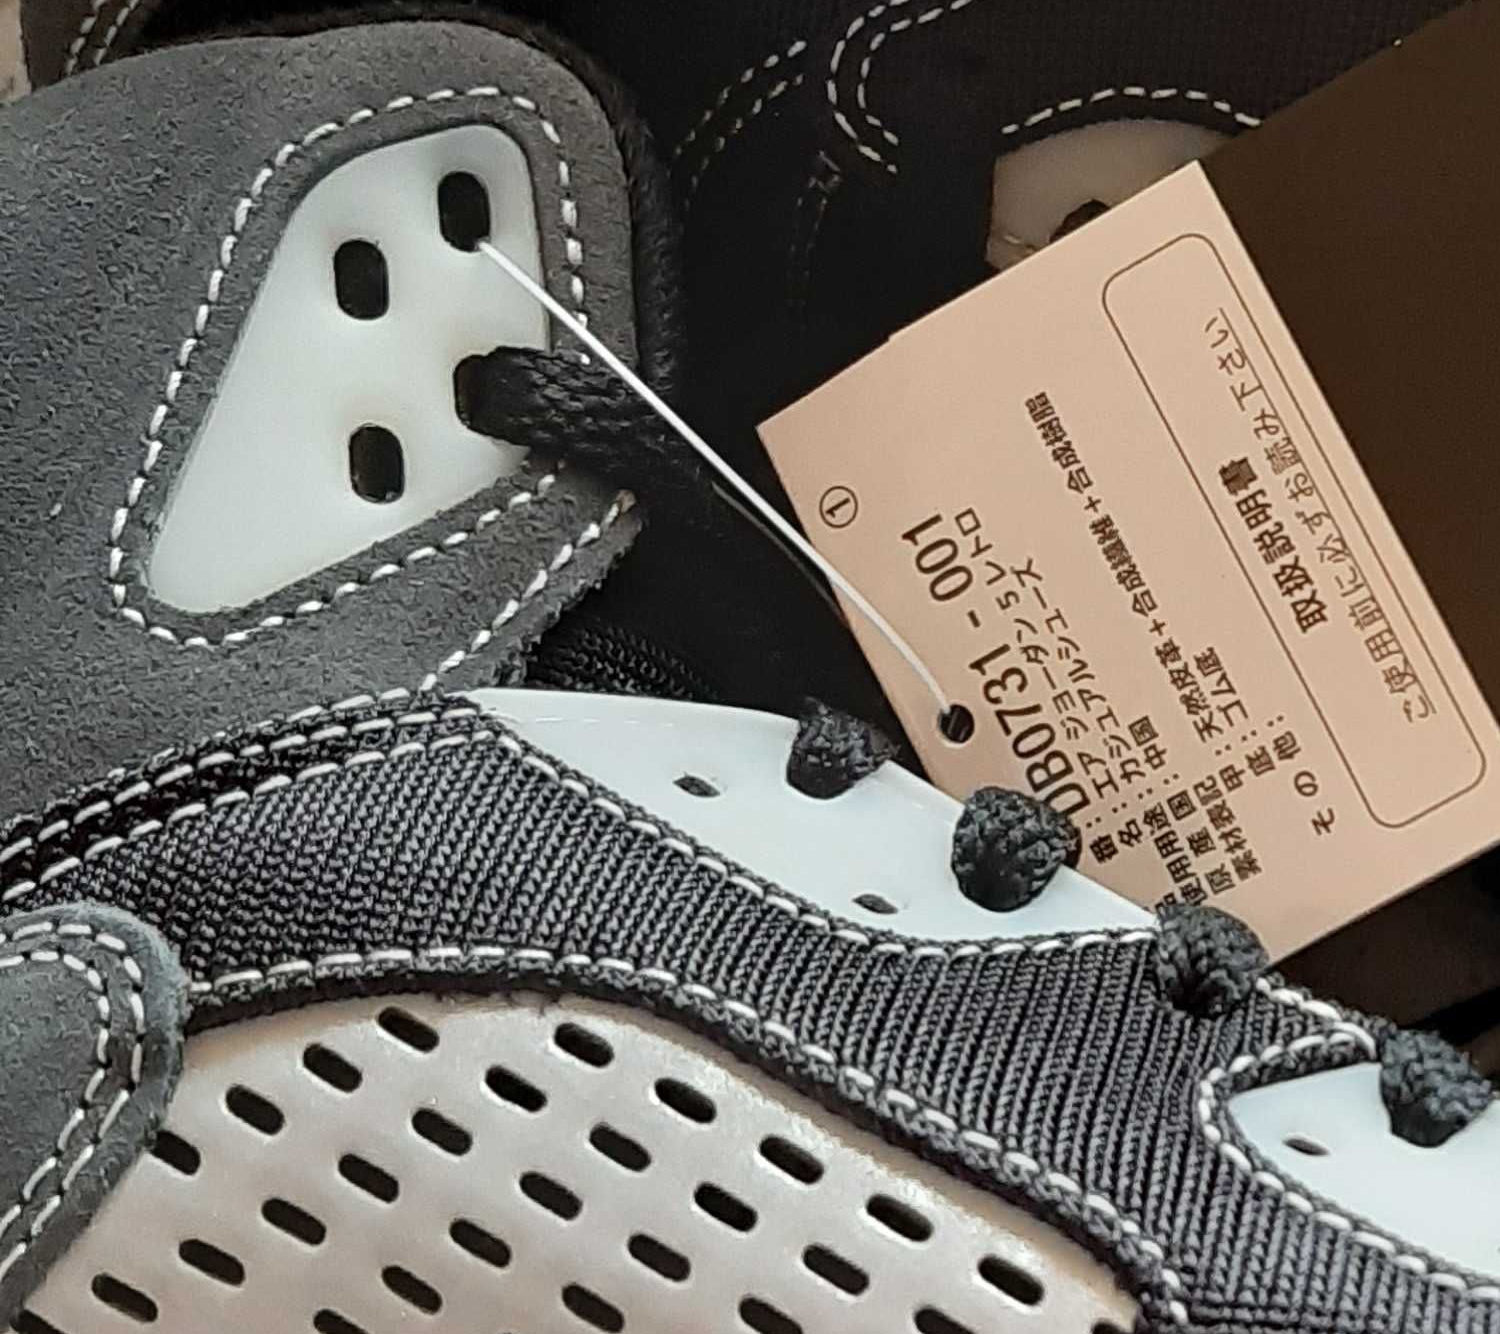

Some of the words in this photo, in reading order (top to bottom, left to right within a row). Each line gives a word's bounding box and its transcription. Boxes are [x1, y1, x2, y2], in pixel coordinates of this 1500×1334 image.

[900, 513, 973, 601] 001
[1204, 309, 1429, 722] ご使用前に必ずお読み下さい
[1218, 456, 1328, 633] 取扱説明書
[968, 643, 1091, 822] DB0731
[1192, 774, 1261, 881] 素材表記
